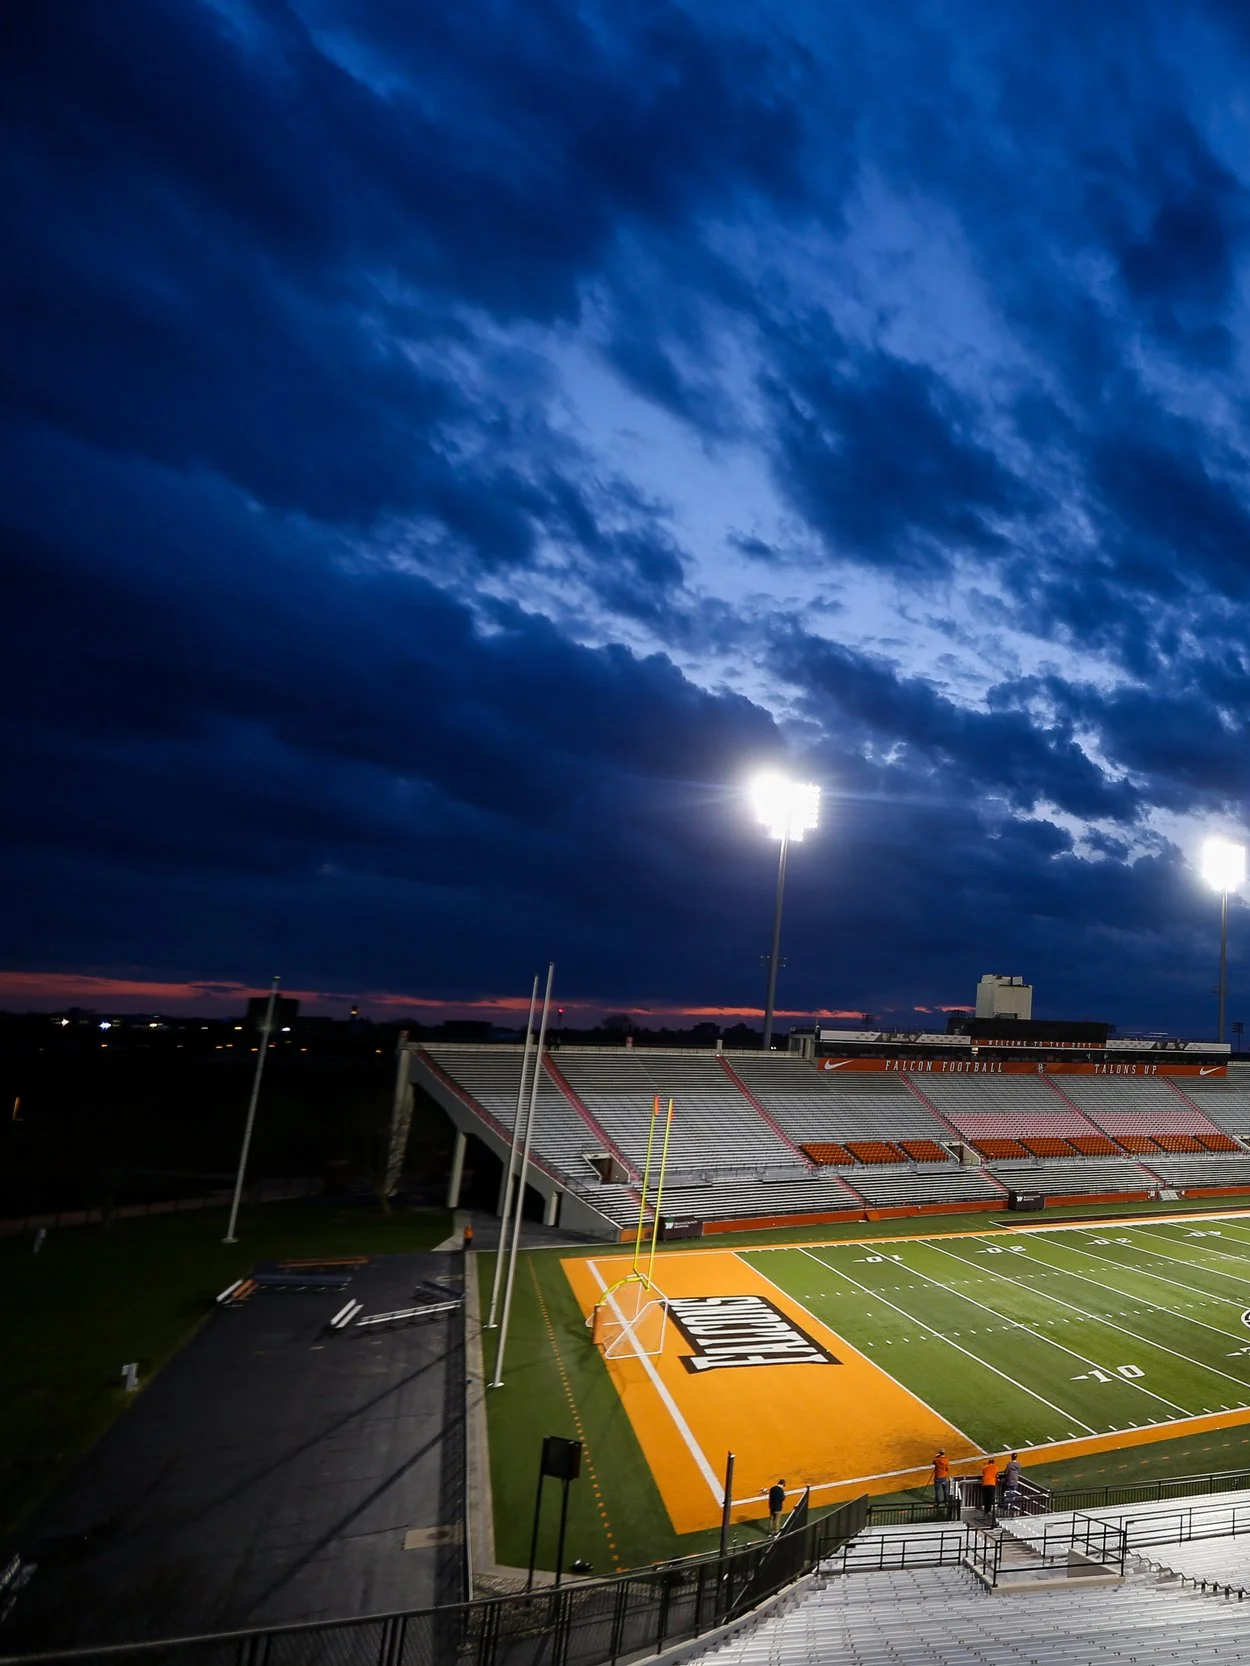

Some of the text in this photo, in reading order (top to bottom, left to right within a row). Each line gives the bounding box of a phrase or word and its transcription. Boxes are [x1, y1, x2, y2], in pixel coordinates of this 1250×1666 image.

[885, 1060, 1003, 1073] FALCON FOOTBALL
[1094, 1064, 1157, 1075] TALONS UP
[1087, 1364, 1146, 1383] 10
